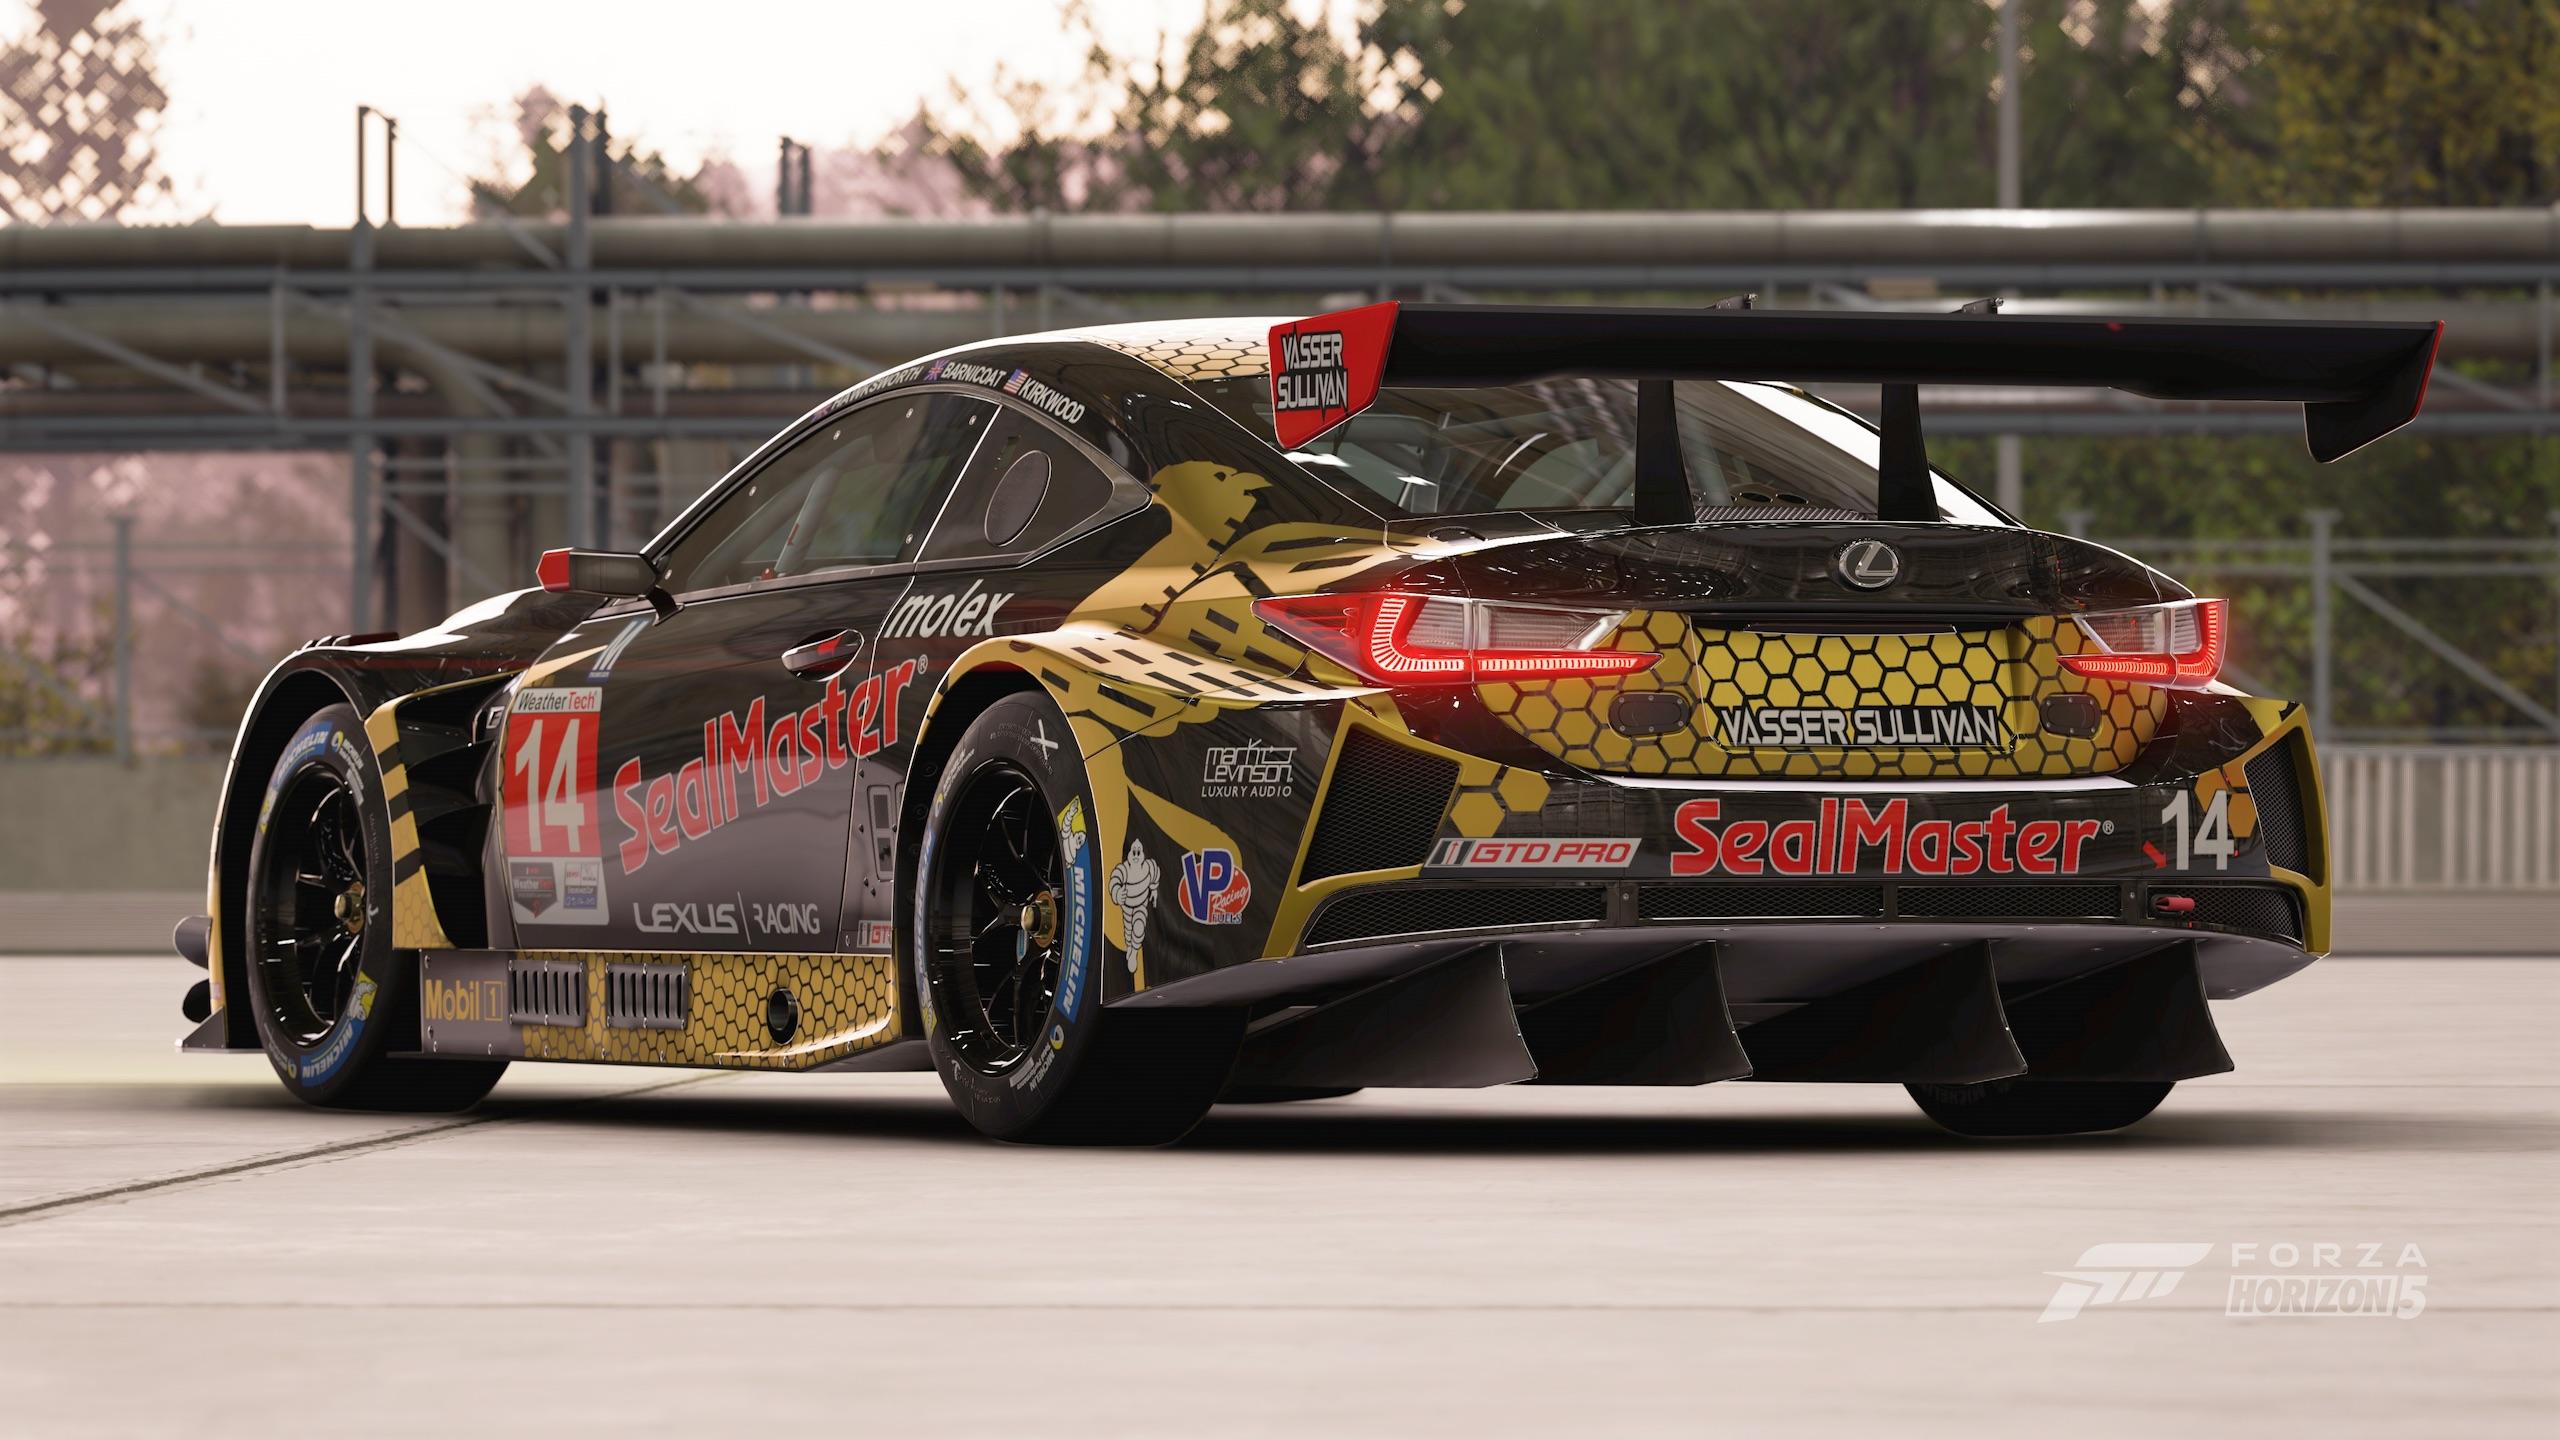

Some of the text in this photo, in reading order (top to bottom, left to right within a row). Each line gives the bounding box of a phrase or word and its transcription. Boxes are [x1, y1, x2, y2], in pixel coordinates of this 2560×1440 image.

[1282, 333, 1343, 372] VASSER
[941, 361, 1006, 387] BARNICOAT
[1277, 369, 1348, 410] SULLIVAN
[1018, 376, 1086, 424] KIRKWOOD
[883, 578, 1015, 639] molex
[517, 690, 599, 712] WeatherTech
[1721, 709, 1851, 747] VASSER
[1854, 706, 2000, 747] SULLIVAN
[515, 718, 585, 853] 14
[1201, 785, 1293, 798] LUXURY AUDIO
[2161, 789, 2235, 871] 14
[1470, 842, 1632, 864] GTD PRO
[1181, 848, 1235, 925] VP
[1211, 886, 1250, 914] Racing
[633, 902, 821, 935] LEXUS RACING
[1063, 866, 1086, 1016] MICHELIN
[425, 979, 480, 1021] Mobil
